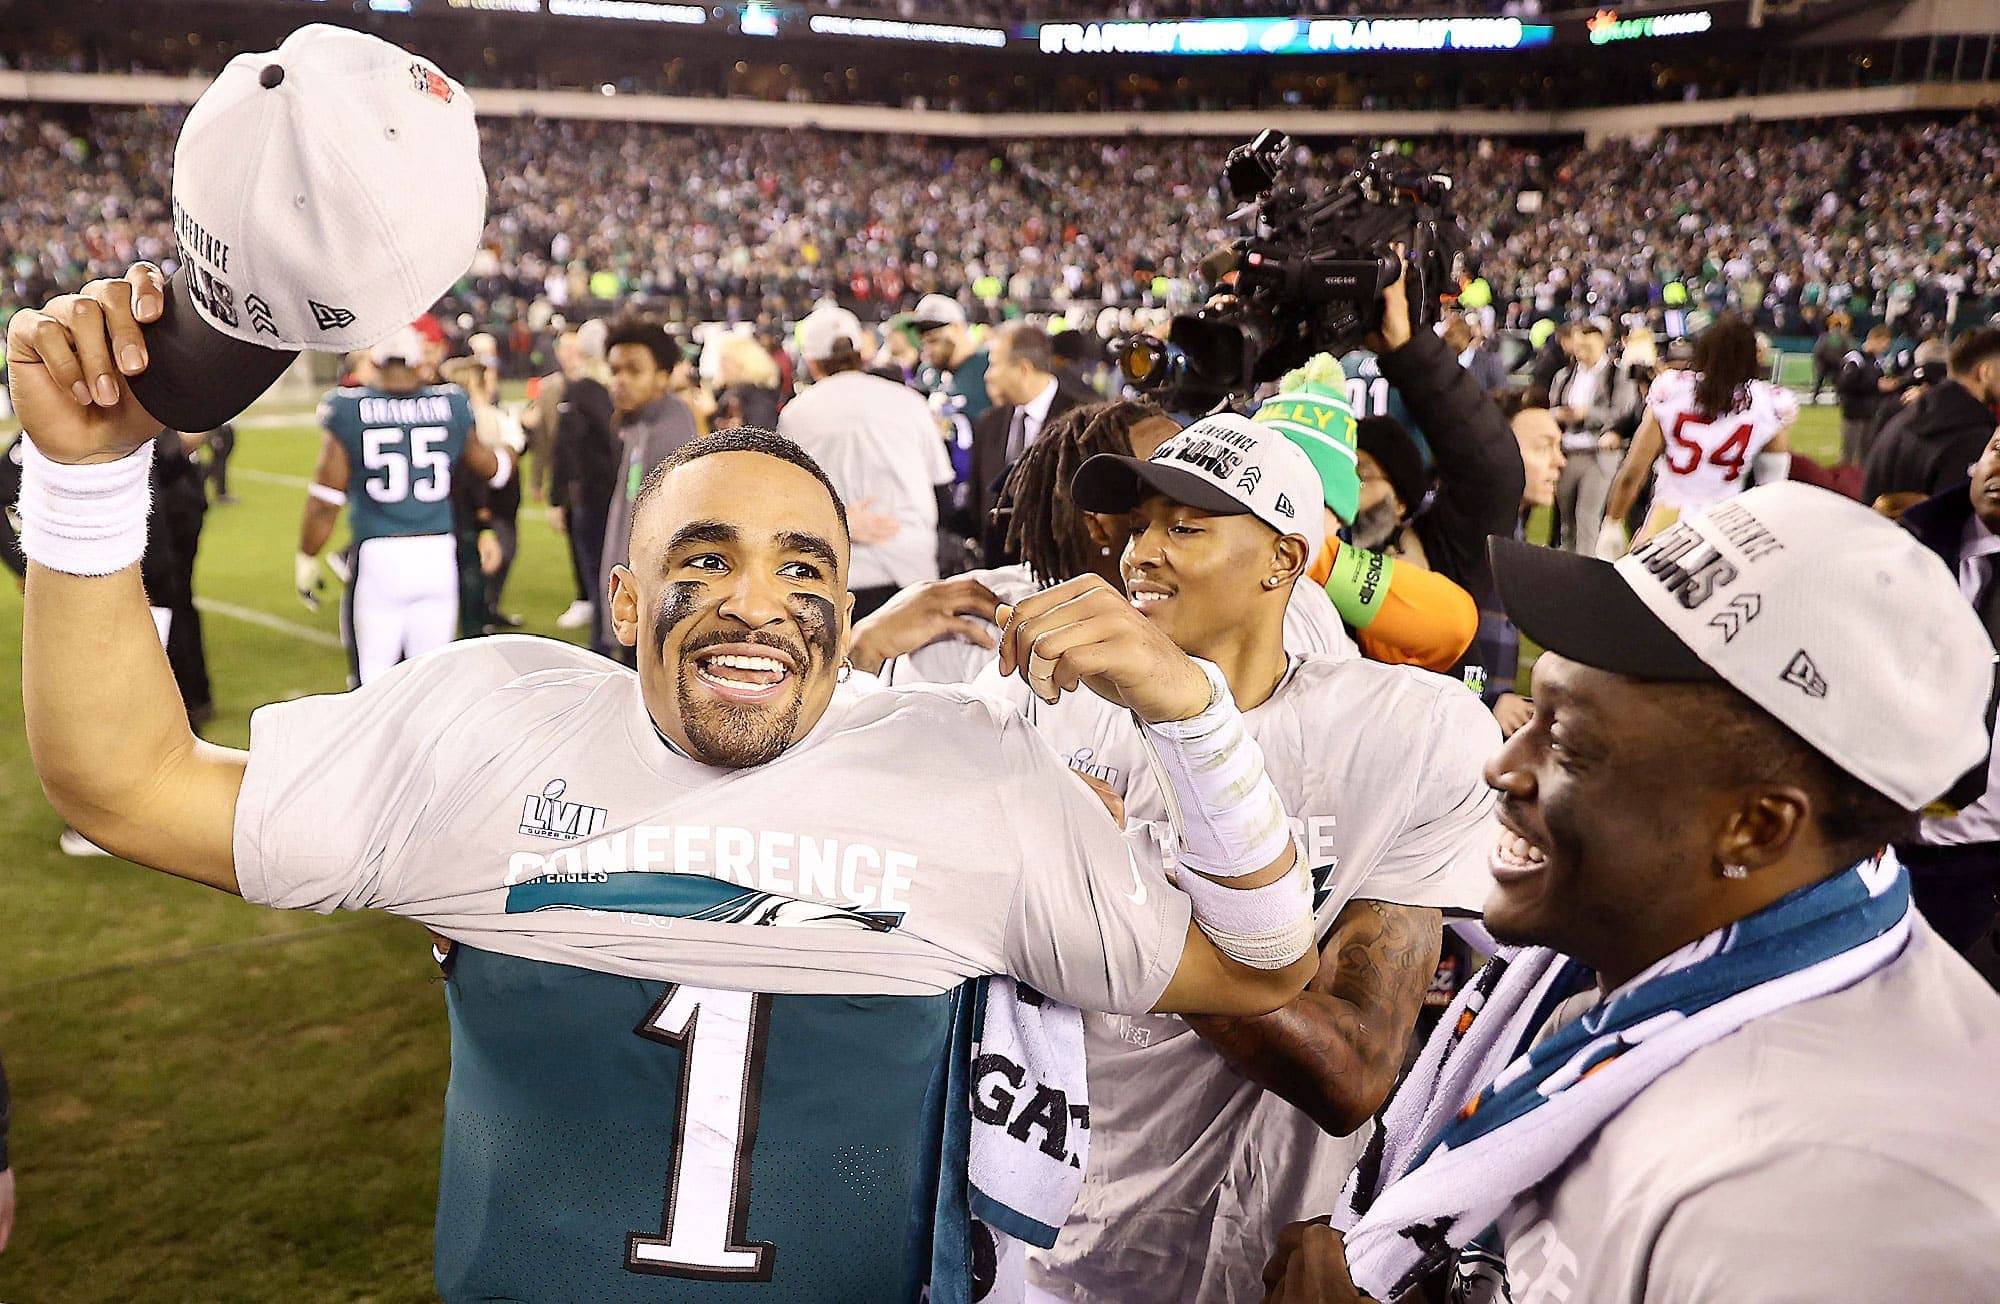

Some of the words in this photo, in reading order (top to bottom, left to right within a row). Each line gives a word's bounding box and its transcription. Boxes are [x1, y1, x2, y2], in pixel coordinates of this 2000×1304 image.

[362, 426, 452, 504] 55
[1666, 412, 1753, 481] 54
[527, 828, 560, 838] SUPER
[624, 983, 777, 1283] 1
